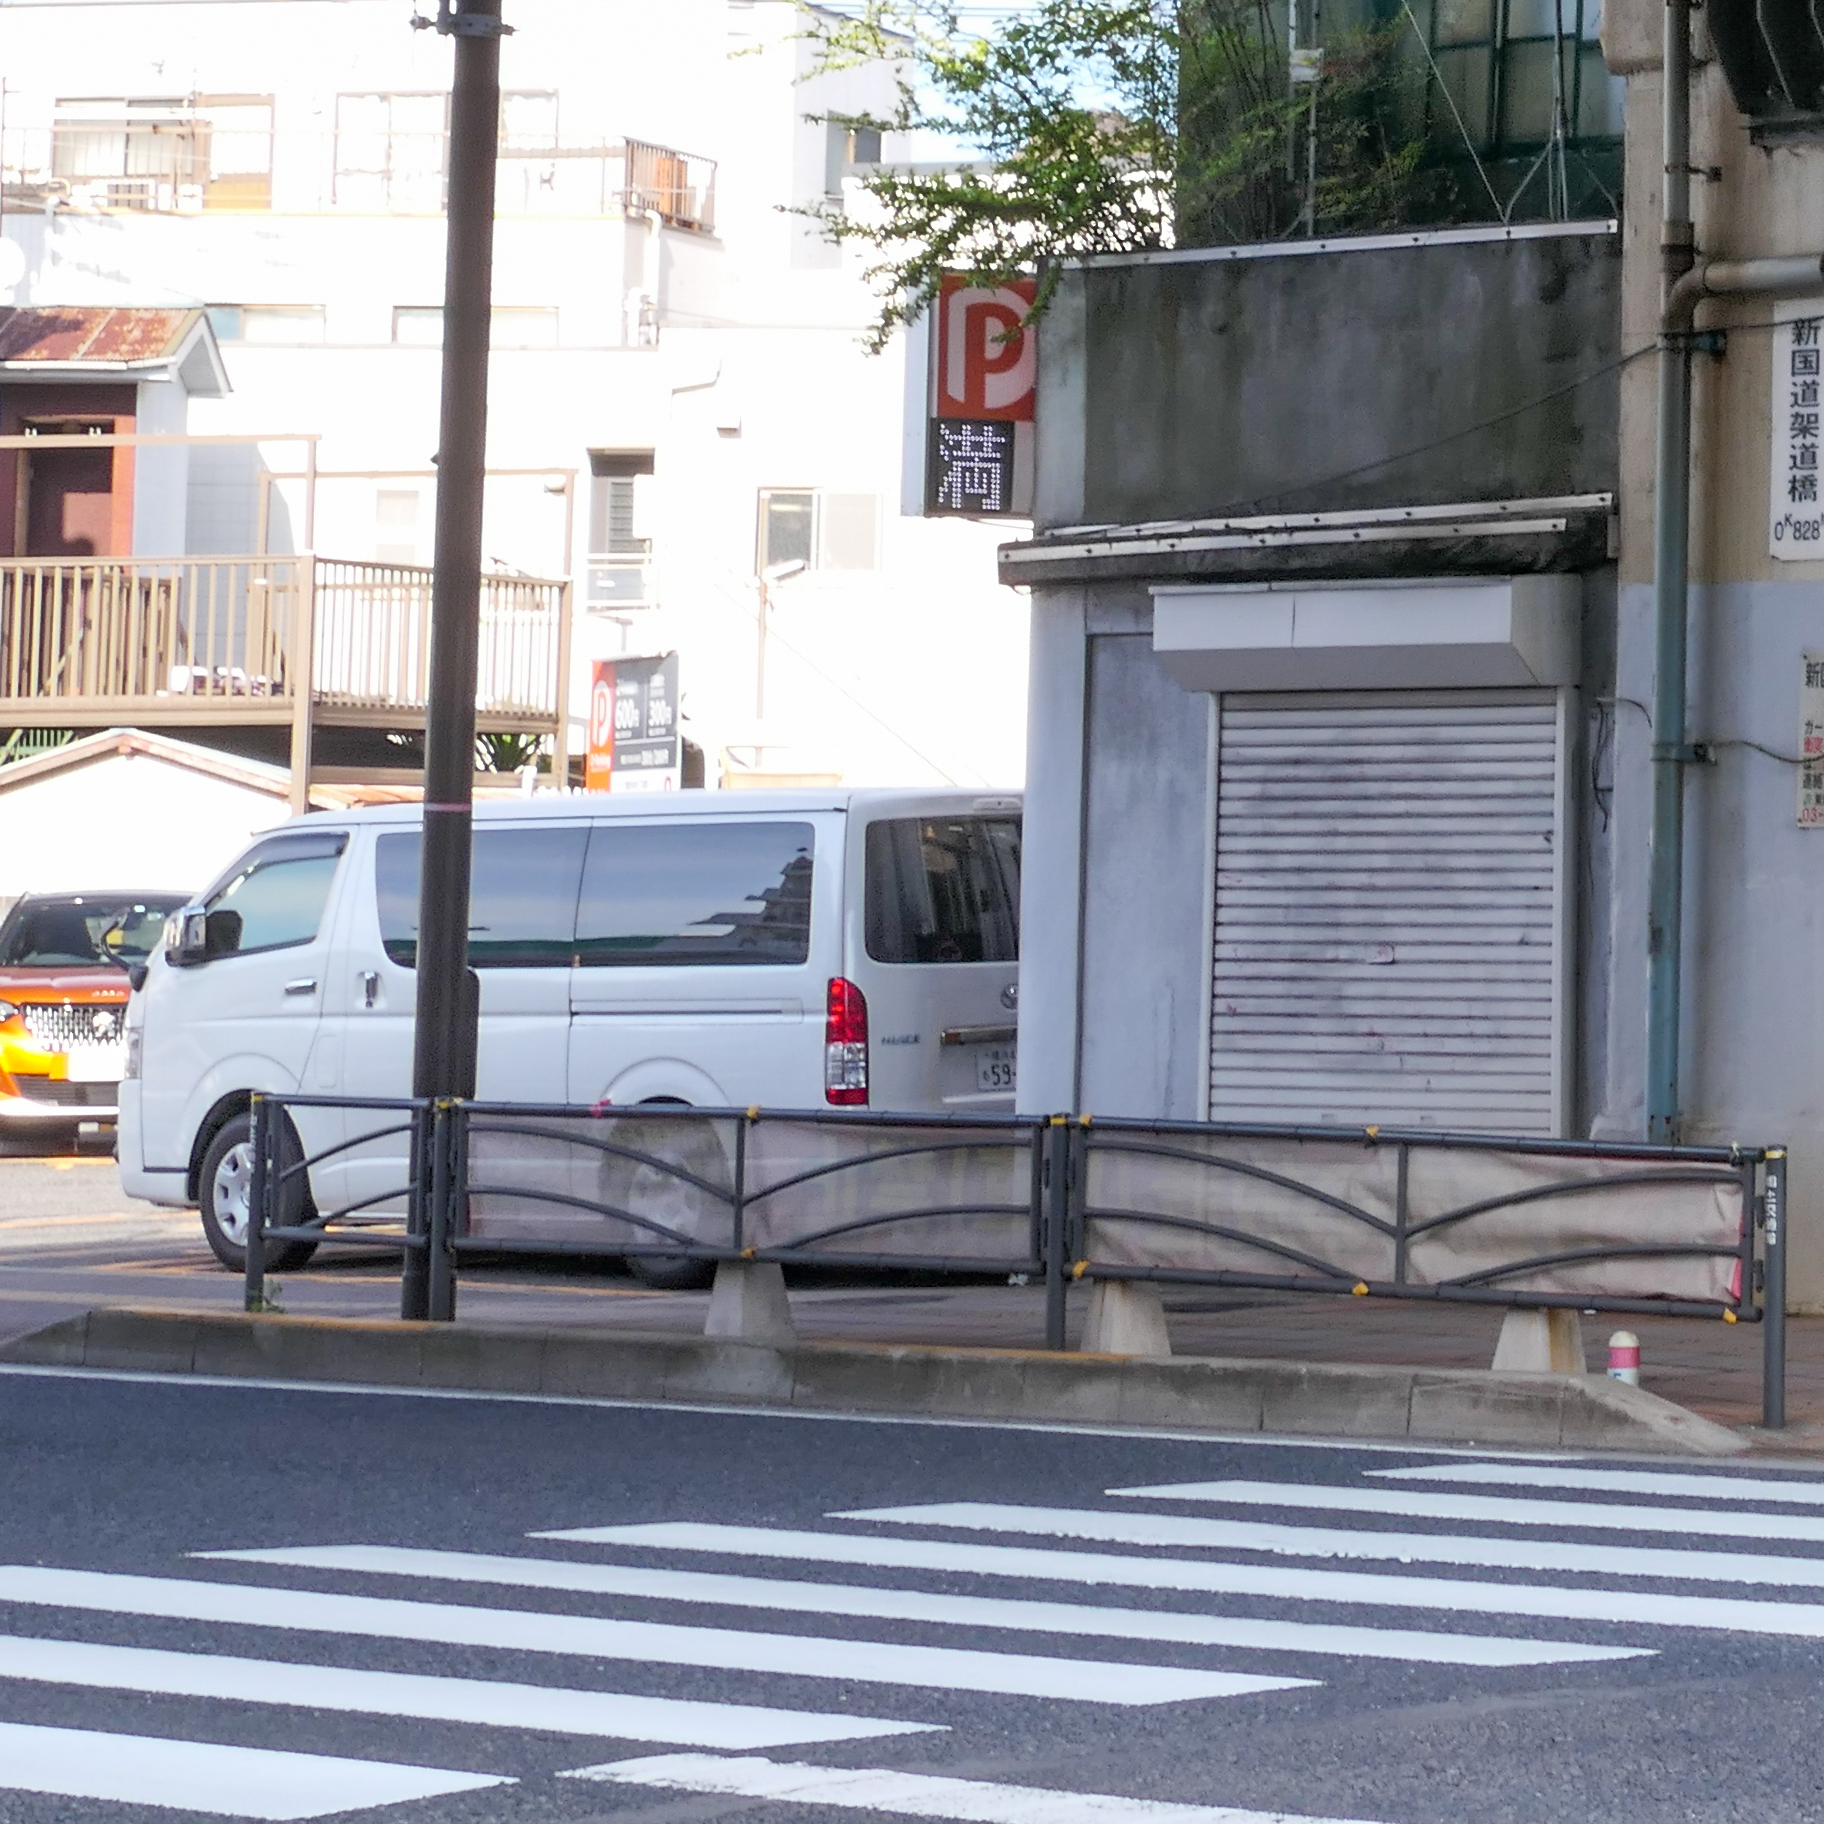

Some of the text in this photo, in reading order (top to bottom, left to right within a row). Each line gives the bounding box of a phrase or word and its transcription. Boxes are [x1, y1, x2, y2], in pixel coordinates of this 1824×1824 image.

[939, 423, 1006, 511] 満
[1788, 318, 1821, 503] 新国道架道橋
